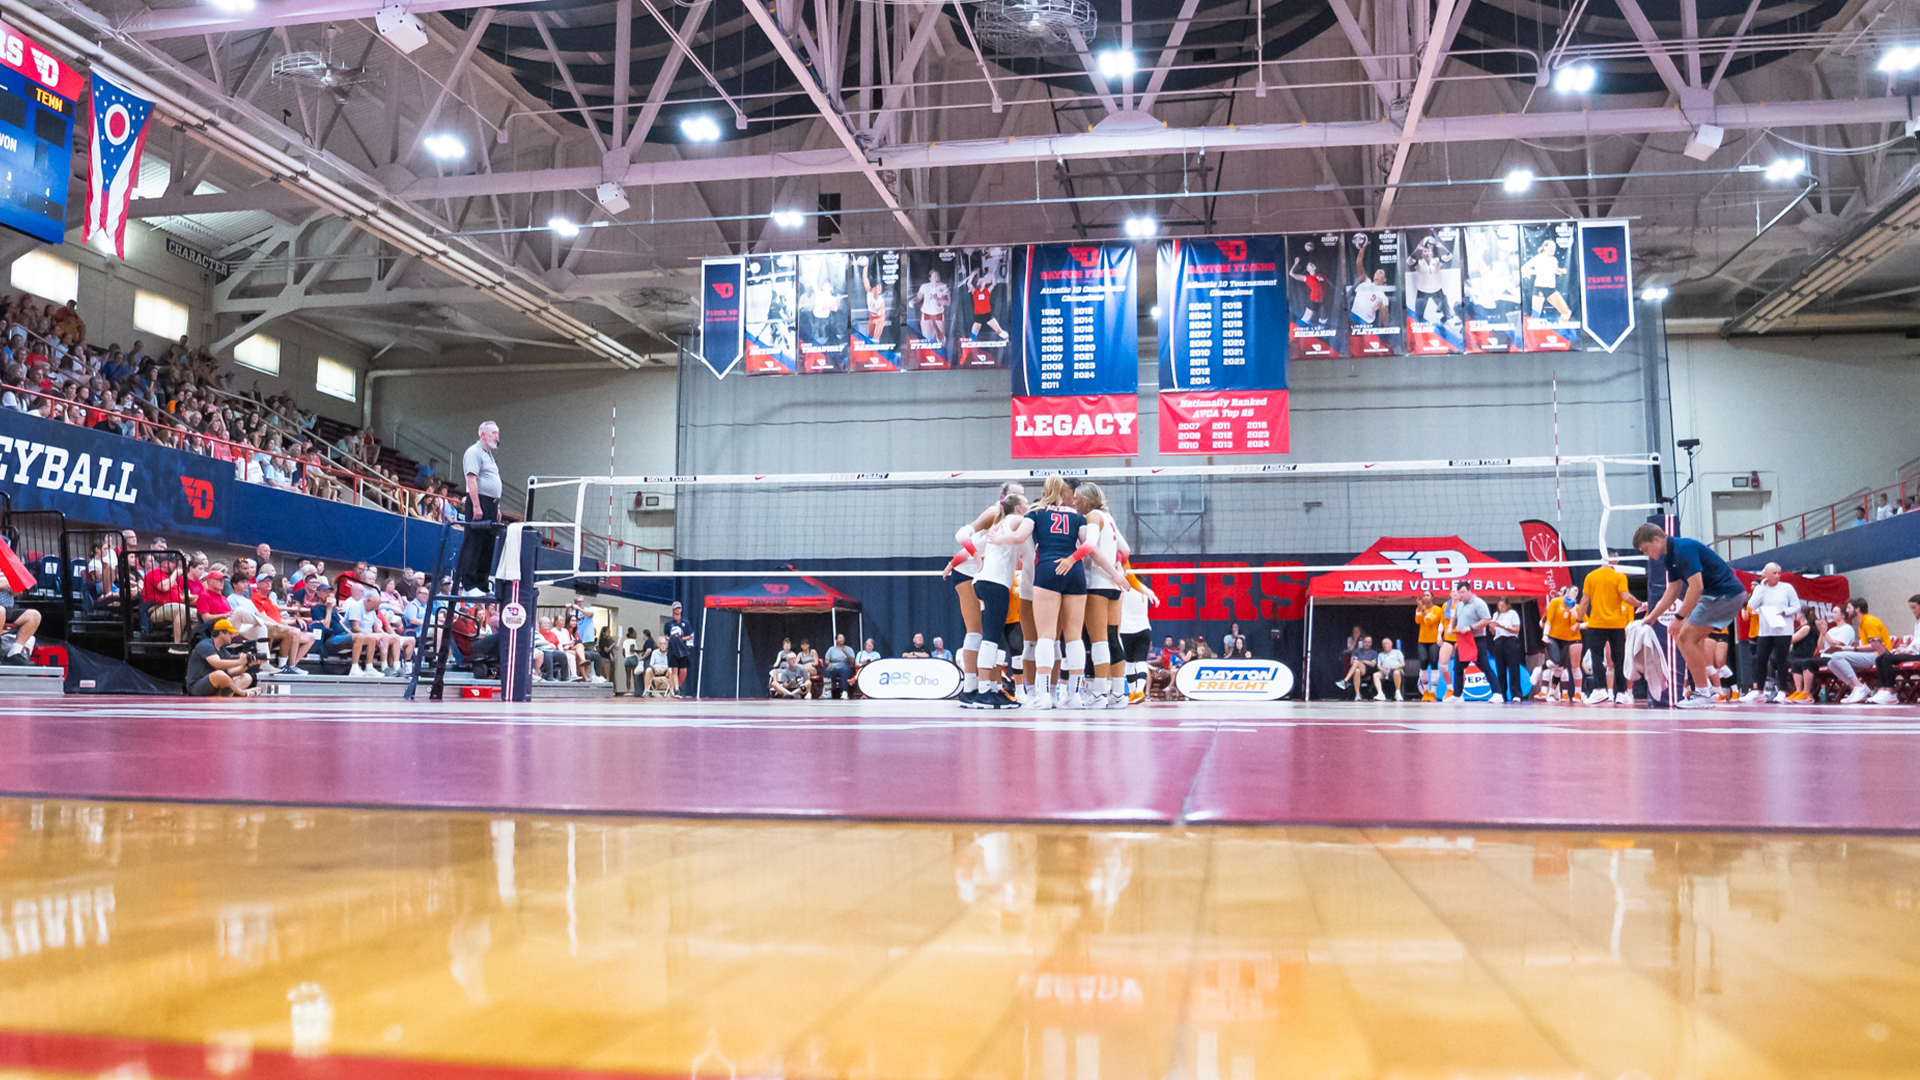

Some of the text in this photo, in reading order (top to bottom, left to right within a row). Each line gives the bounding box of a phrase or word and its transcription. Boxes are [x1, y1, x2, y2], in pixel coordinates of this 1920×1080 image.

[36, 87, 64, 113] TENN
[168, 240, 228, 276] CHARACTER
[1187, 263, 1275, 274] DAYTON FLYERS
[1041, 269, 1082, 279] DAYTON
[1229, 279, 1277, 287] Tournament
[1209, 289, 1253, 297] Champions
[1061, 294, 1105, 303] Champions
[1189, 302, 1212, 311] 2003
[1222, 301, 1242, 309] 2015
[1073, 307, 1094, 315] 2012
[1073, 316, 1094, 324] 2014
[1189, 312, 1212, 320] 2004
[1189, 330, 1212, 338] 2007
[1293, 330, 1336, 338] RICHARDS
[1189, 339, 1213, 348] 2009
[1222, 339, 1245, 347] 2020
[1073, 344, 1096, 352] 2020
[1223, 348, 1243, 356] 2021
[1073, 353, 1094, 361] 2021
[1189, 349, 1211, 357] 2010
[1073, 362, 1096, 370] 2023
[1190, 358, 1208, 366] 2011
[1041, 363, 1064, 371] 2009
[1041, 372, 1062, 380] 2010
[1073, 371, 1095, 379] 2024
[1041, 381, 1059, 389] 2011
[1190, 377, 1211, 385] 2014
[1179, 397, 1267, 408] Nationally Ranked
[1192, 409, 1254, 418] AVCA Top 25
[1015, 413, 1136, 437] LEGACY
[1212, 422, 1230, 430] 2011
[1212, 431, 1233, 439] 2012
[1178, 441, 1199, 449] 2010
[1247, 440, 1269, 448] 2024
[1050, 512, 1070, 535] 21
[1343, 579, 1516, 592] DAYTON VOLLEBALL
[748, 598, 788, 607] DAYTON
[879, 671, 939, 686] aes Ohio
[1200, 669, 1271, 680] DAYTON
[1465, 676, 1488, 684] EPS
[1197, 681, 1268, 690] FREIGHT
